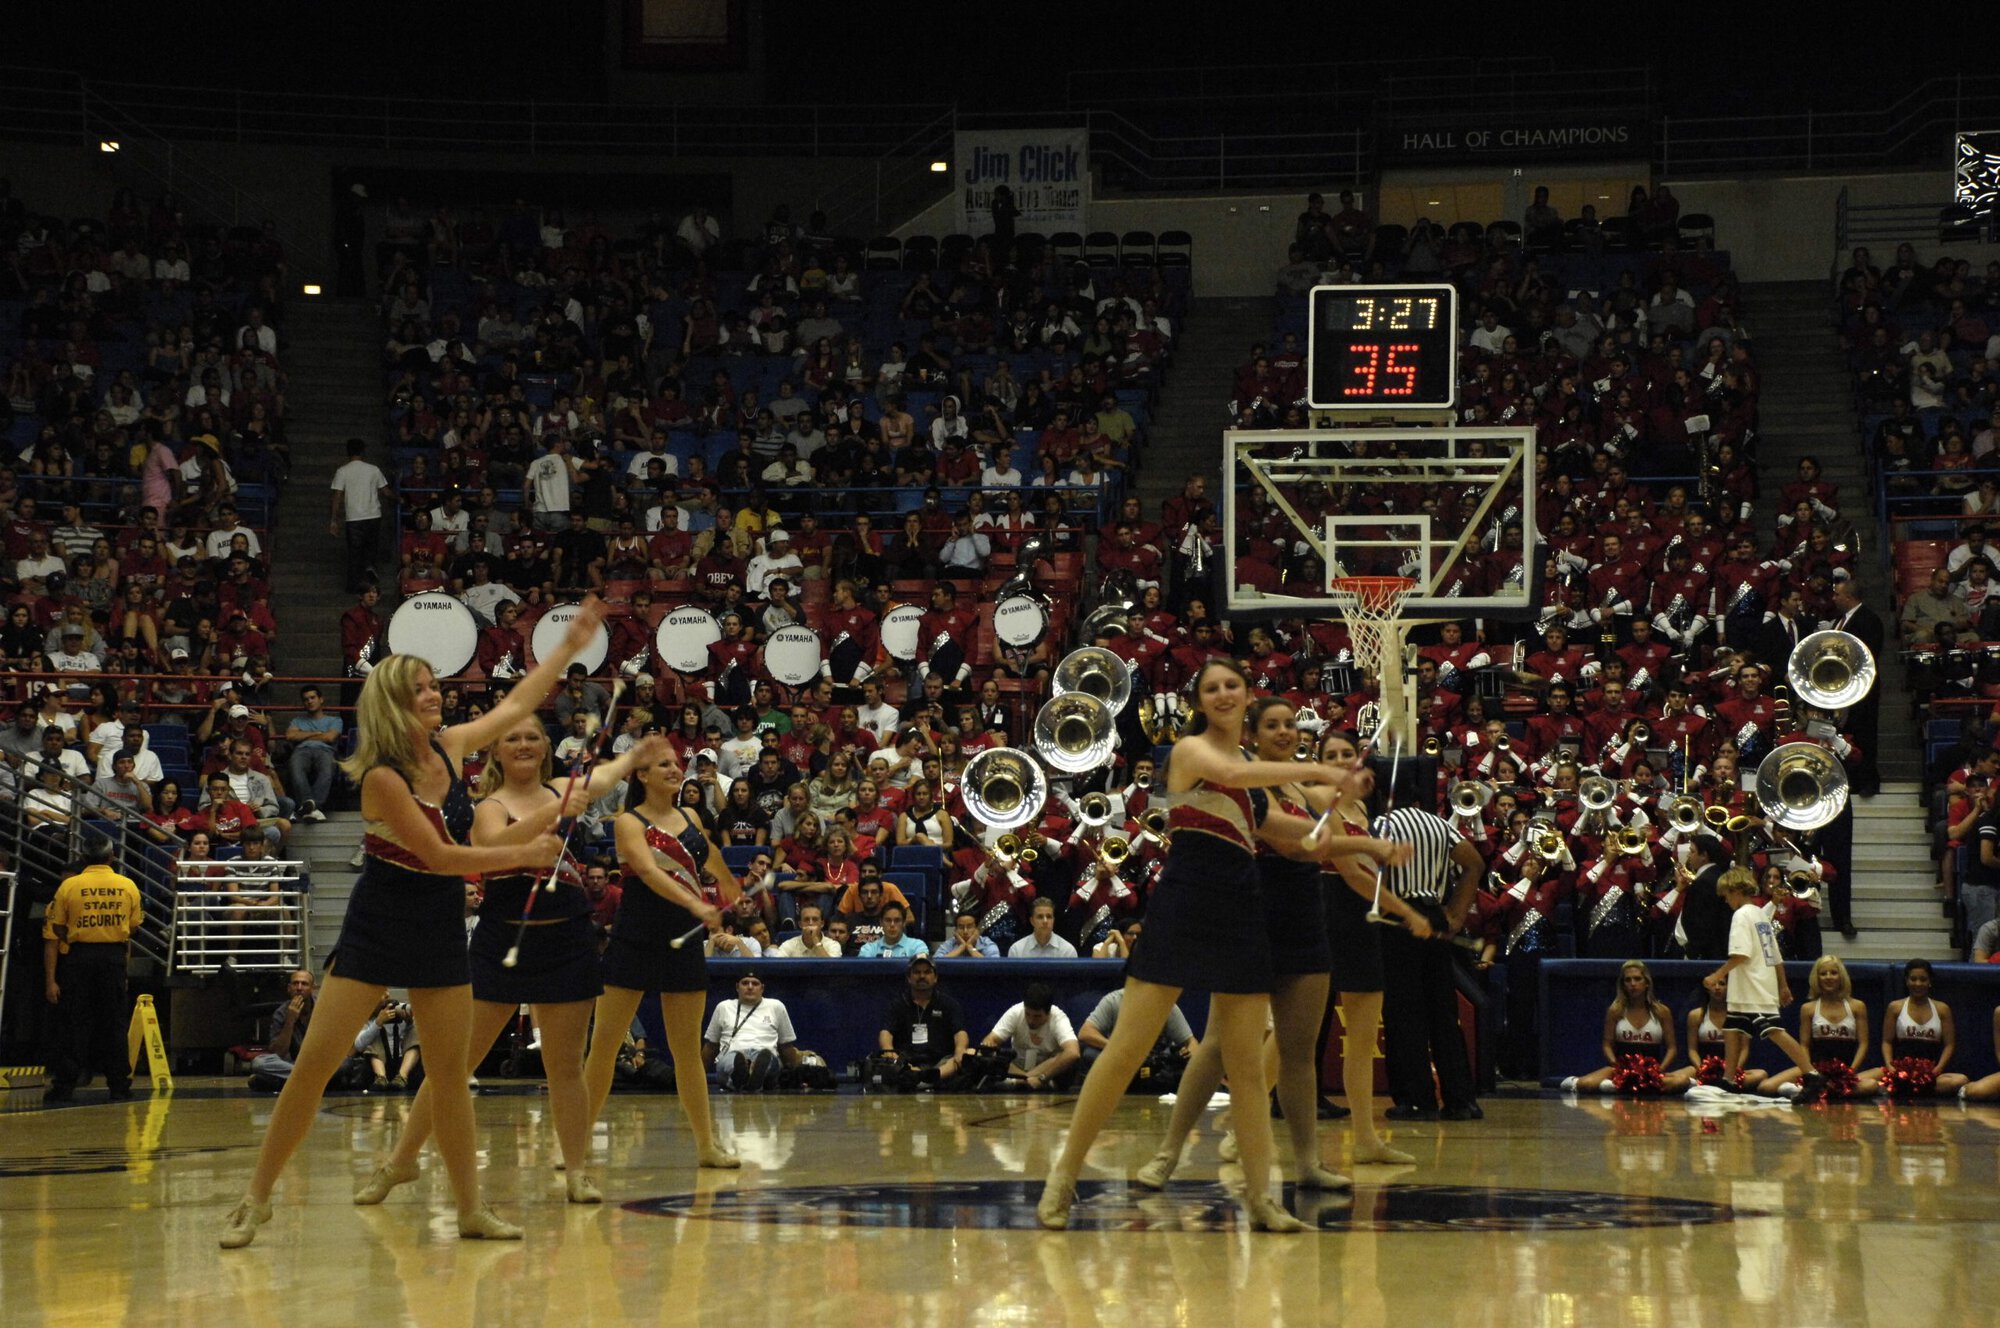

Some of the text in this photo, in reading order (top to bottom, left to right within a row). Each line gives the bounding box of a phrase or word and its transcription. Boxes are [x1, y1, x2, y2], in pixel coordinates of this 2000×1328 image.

[1403, 126, 1629, 150] HALL OF CHAMPIONS
[965, 144, 1080, 185] Jim Click
[1352, 298, 1438, 330] 3:27
[1343, 343, 1420, 396] 35
[422, 601, 453, 611] YAMAHA
[1008, 603, 1032, 615] YAMAHA
[677, 615, 707, 625] YAMAHA
[784, 633, 813, 643] YAMAHA
[80, 887, 125, 897] EVENT
[83, 901, 123, 910] STAFF
[76, 913, 127, 928] SECURITY
